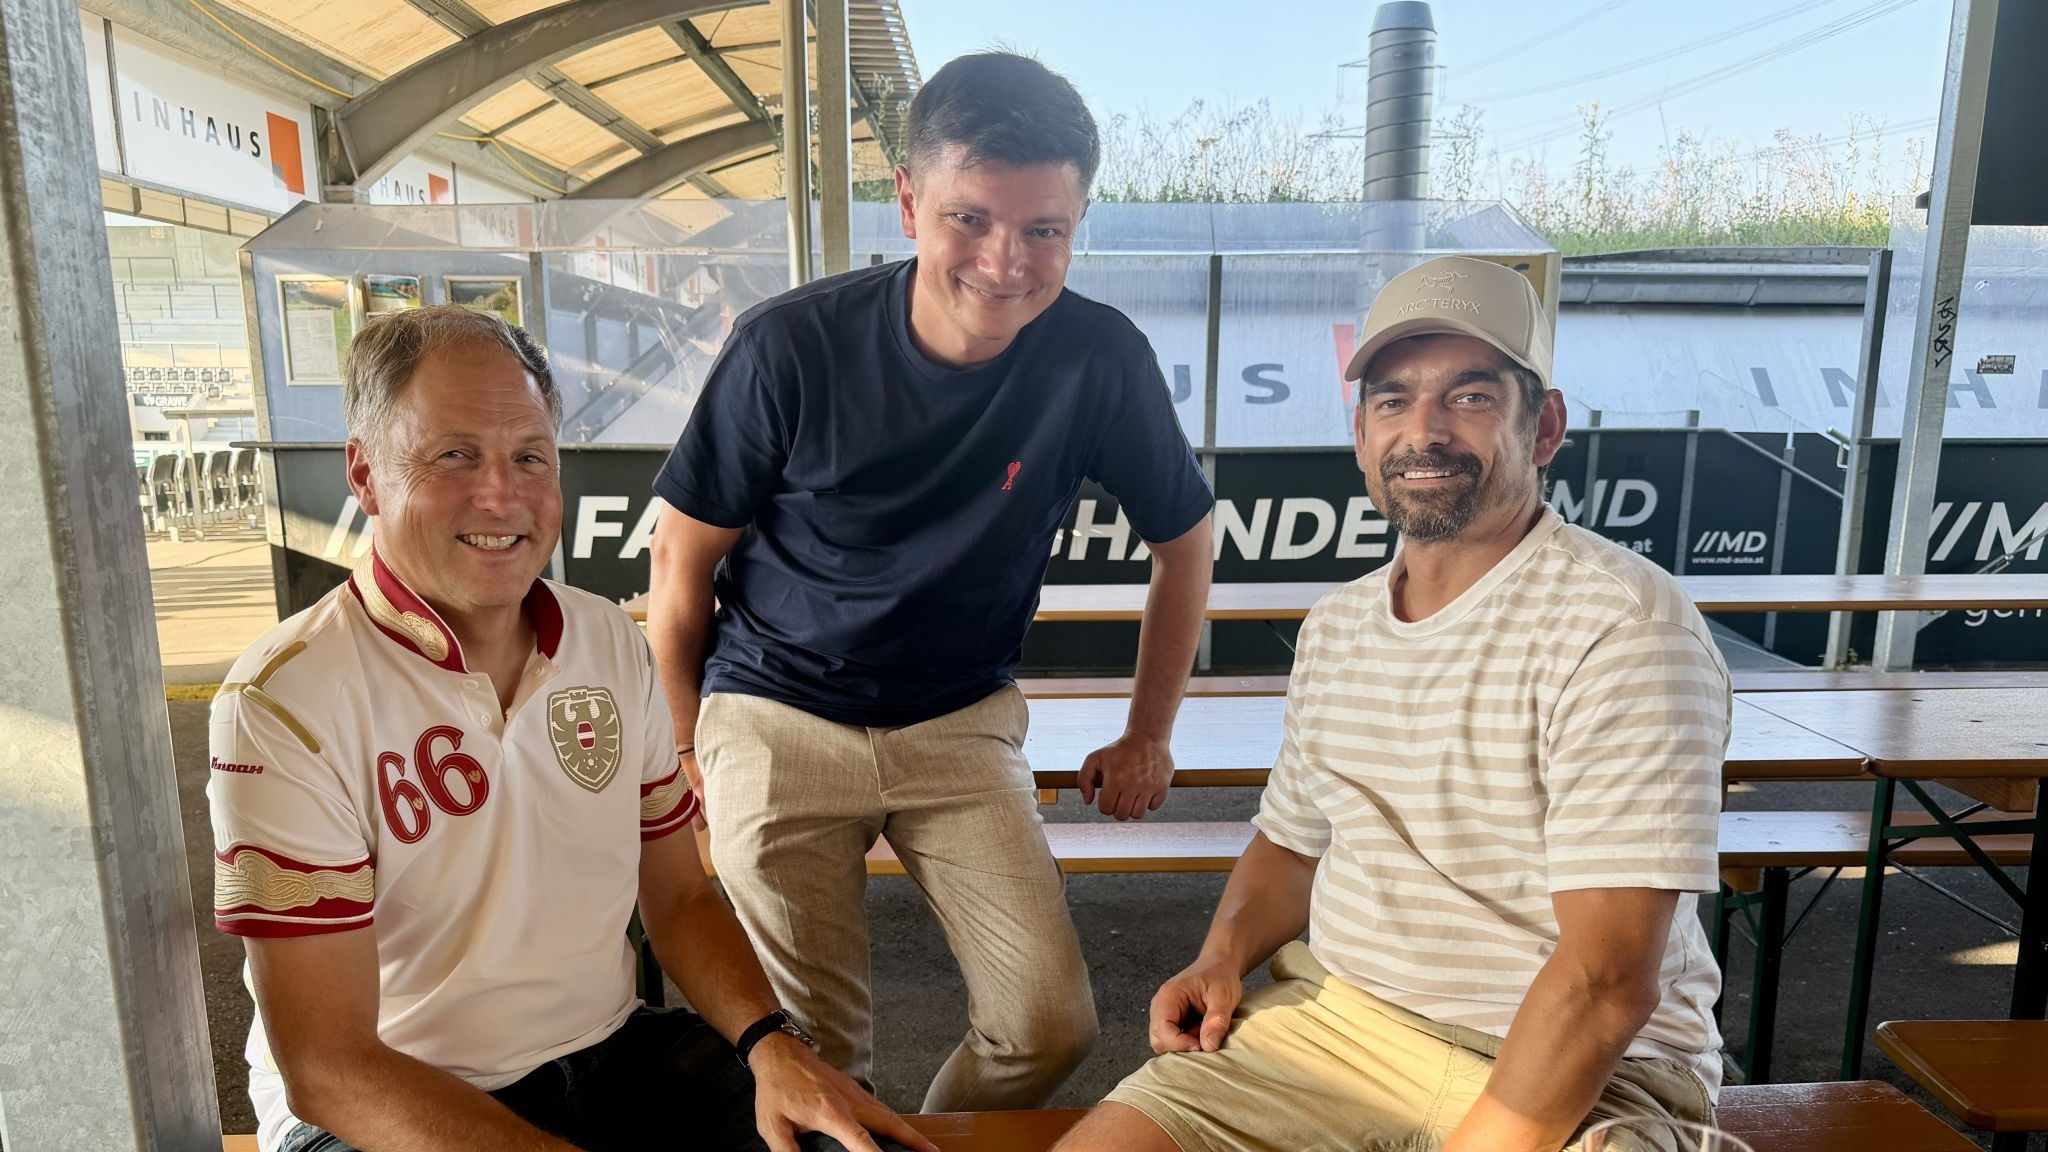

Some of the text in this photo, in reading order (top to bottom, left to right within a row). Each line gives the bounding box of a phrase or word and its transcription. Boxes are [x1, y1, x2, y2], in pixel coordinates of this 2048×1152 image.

[133, 90, 261, 158] INHAUS
[1692, 556, 1765, 564] www.md-auto.at
[377, 725, 490, 844] 66
